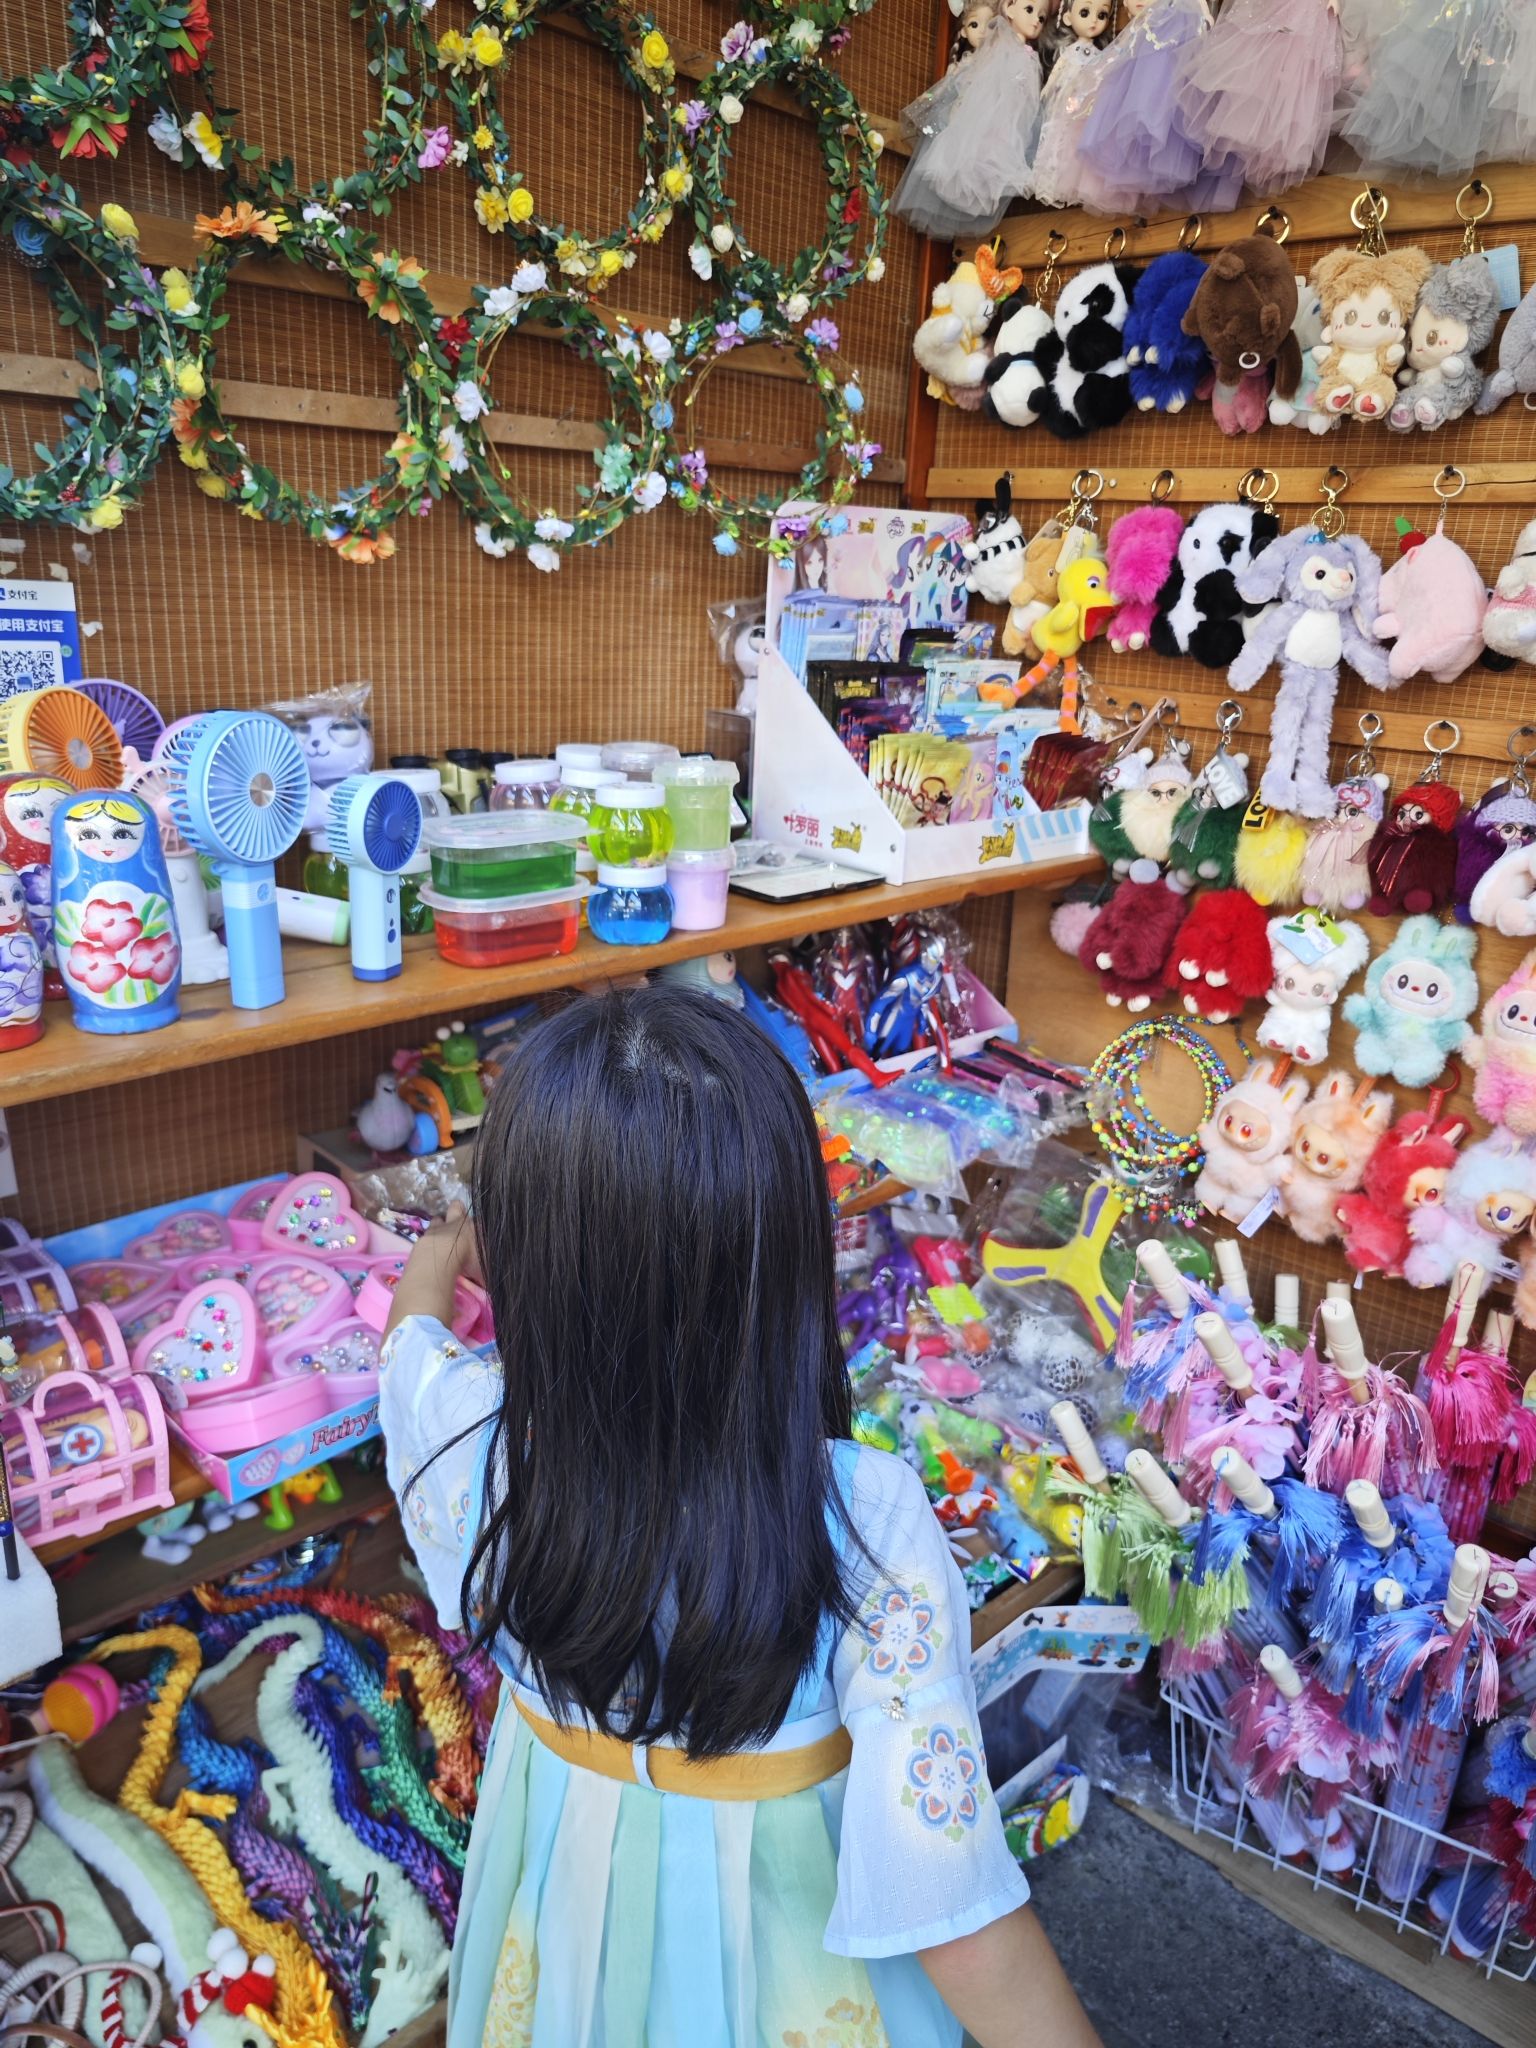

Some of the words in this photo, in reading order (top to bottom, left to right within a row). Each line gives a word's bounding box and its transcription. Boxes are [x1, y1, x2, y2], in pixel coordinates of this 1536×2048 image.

[8, 590, 37, 600] 支付宝
[1204, 755, 1244, 806] LOVE
[1245, 790, 1267, 828] LO
